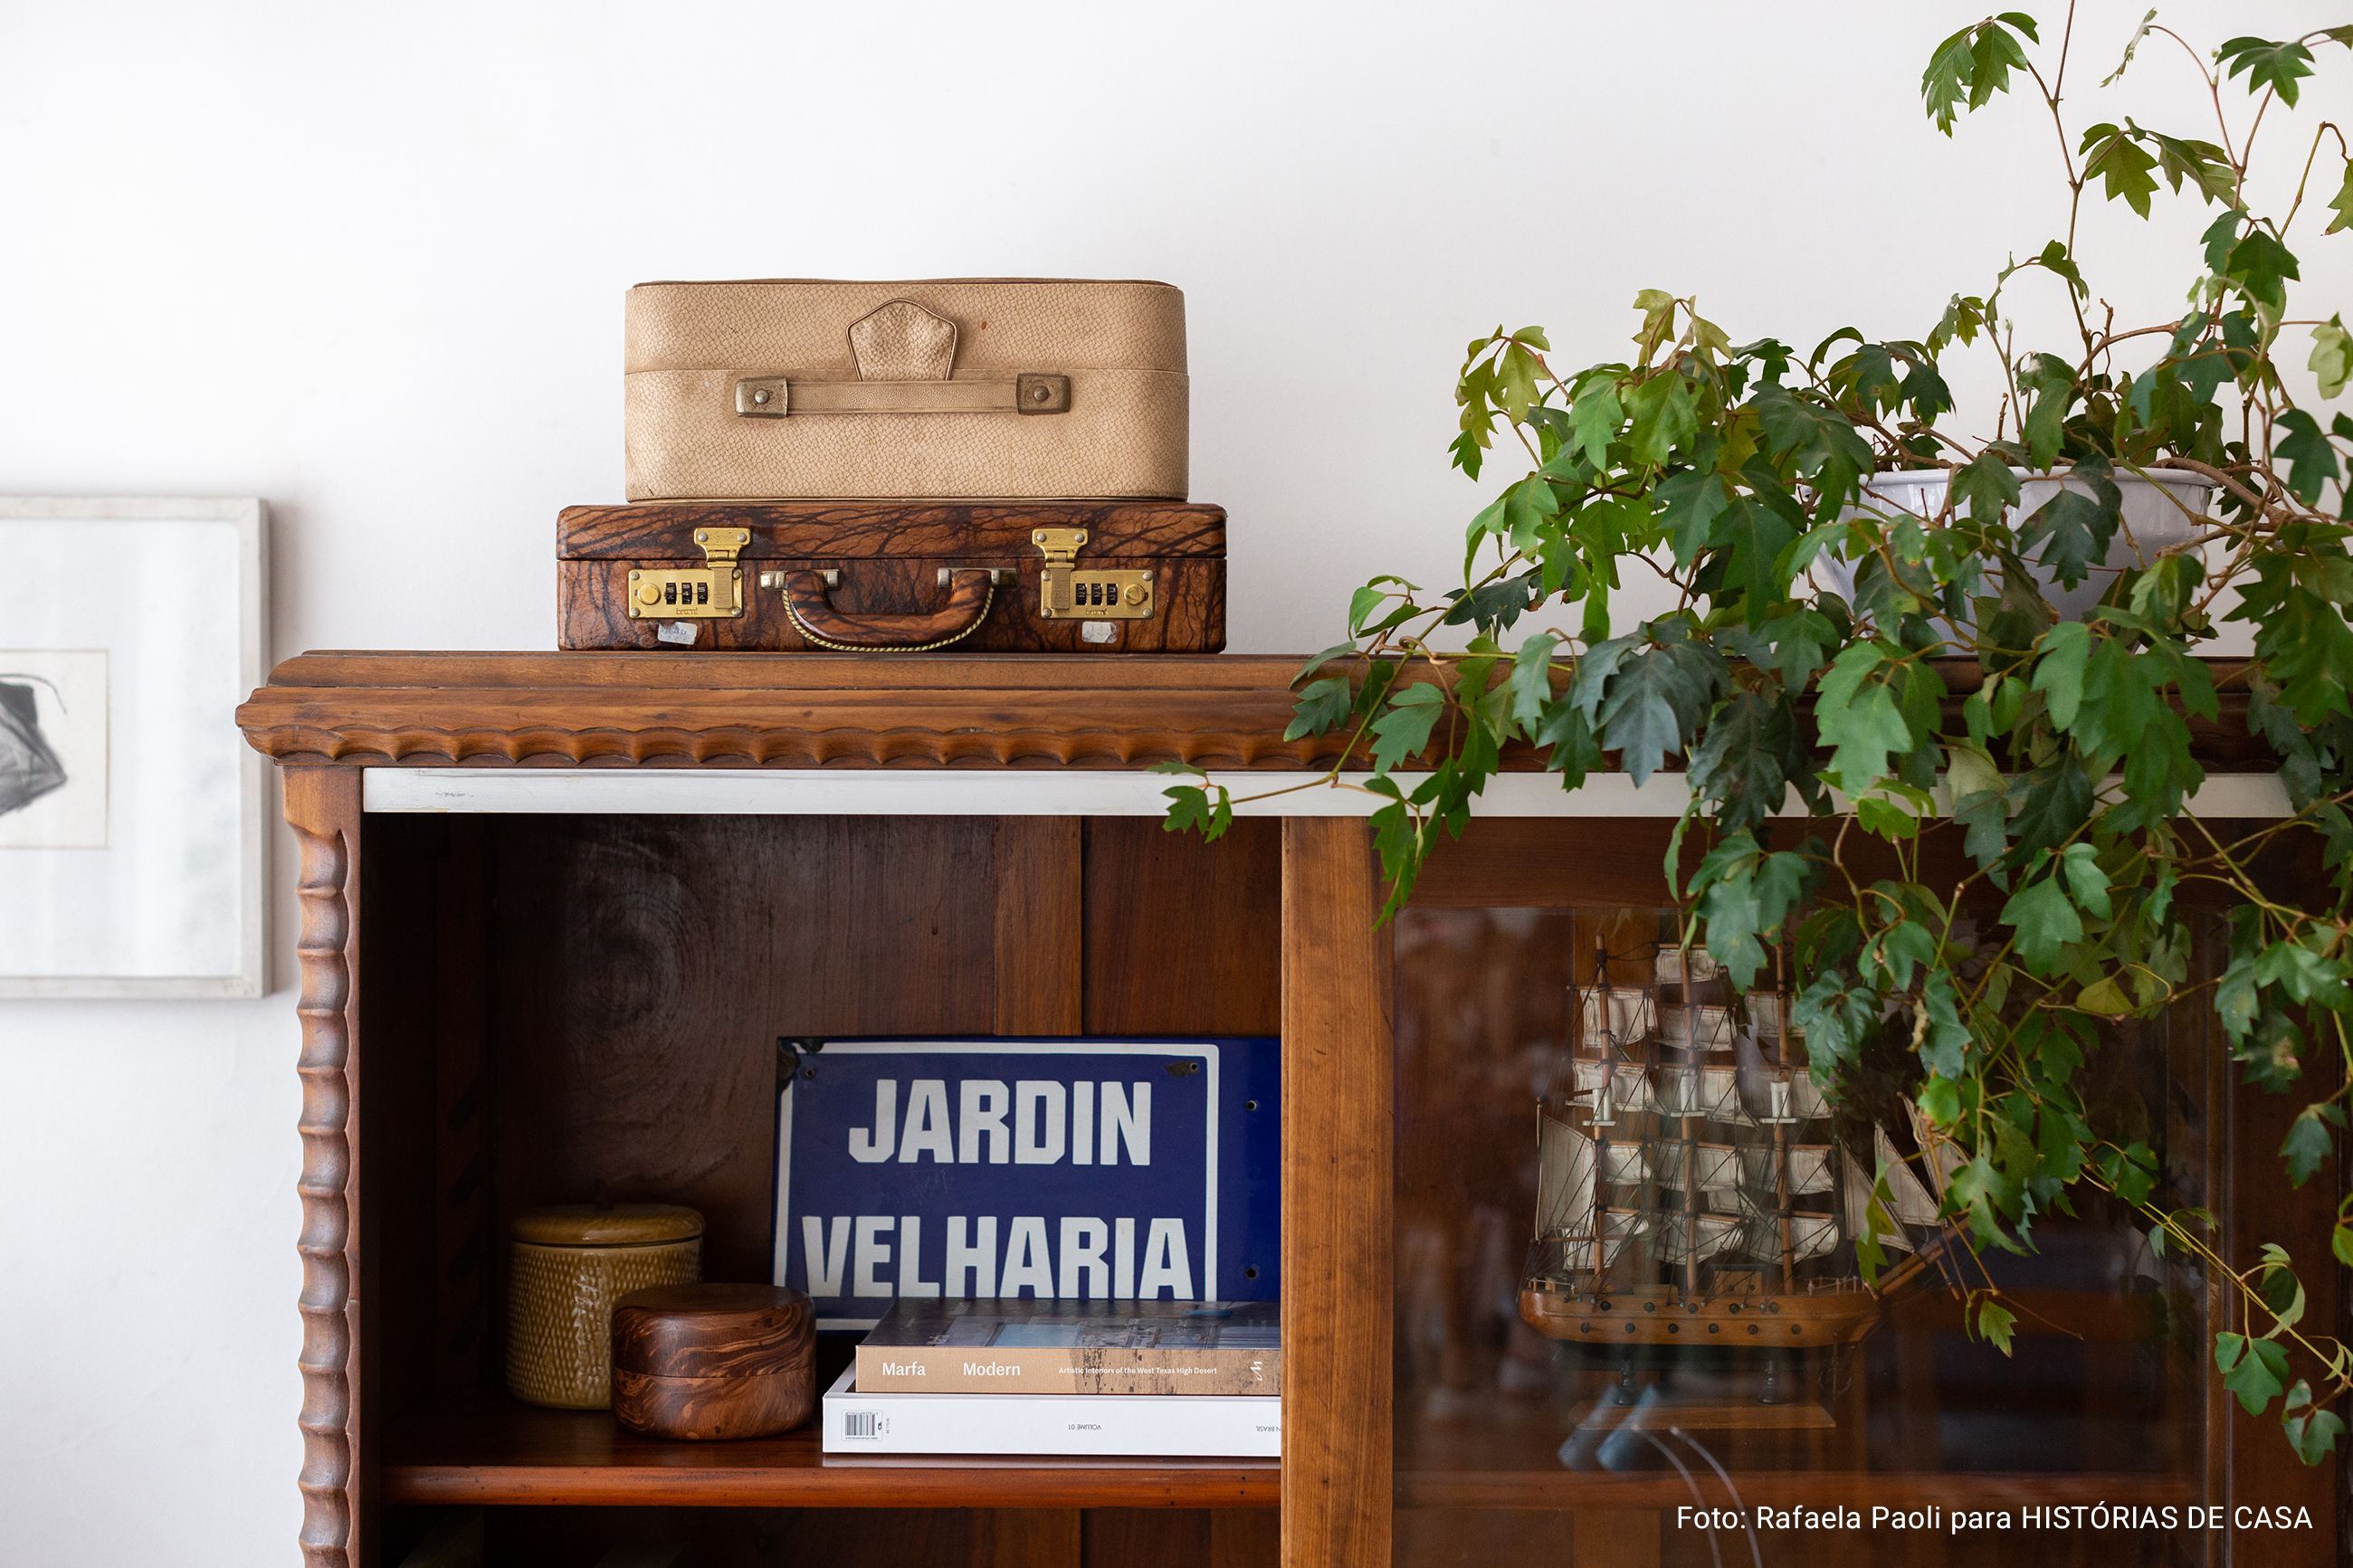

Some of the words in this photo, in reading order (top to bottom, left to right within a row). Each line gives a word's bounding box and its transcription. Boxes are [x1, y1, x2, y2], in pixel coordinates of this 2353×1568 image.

[848, 1079, 1151, 1166] JARDIN
[802, 1216, 1194, 1299] VELHARIA
[882, 1361, 927, 1376] Marfa
[963, 1361, 1021, 1376] Modern
[1058, 1366, 1084, 1374] Artistic
[1085, 1366, 1115, 1374] Interiors
[1115, 1366, 1123, 1374] of
[1124, 1366, 1136, 1374] the
[1137, 1366, 1155, 1374] West
[1156, 1366, 1176, 1374] Texas
[1176, 1366, 1193, 1376] High
[1194, 1366, 1217, 1374] Desert
